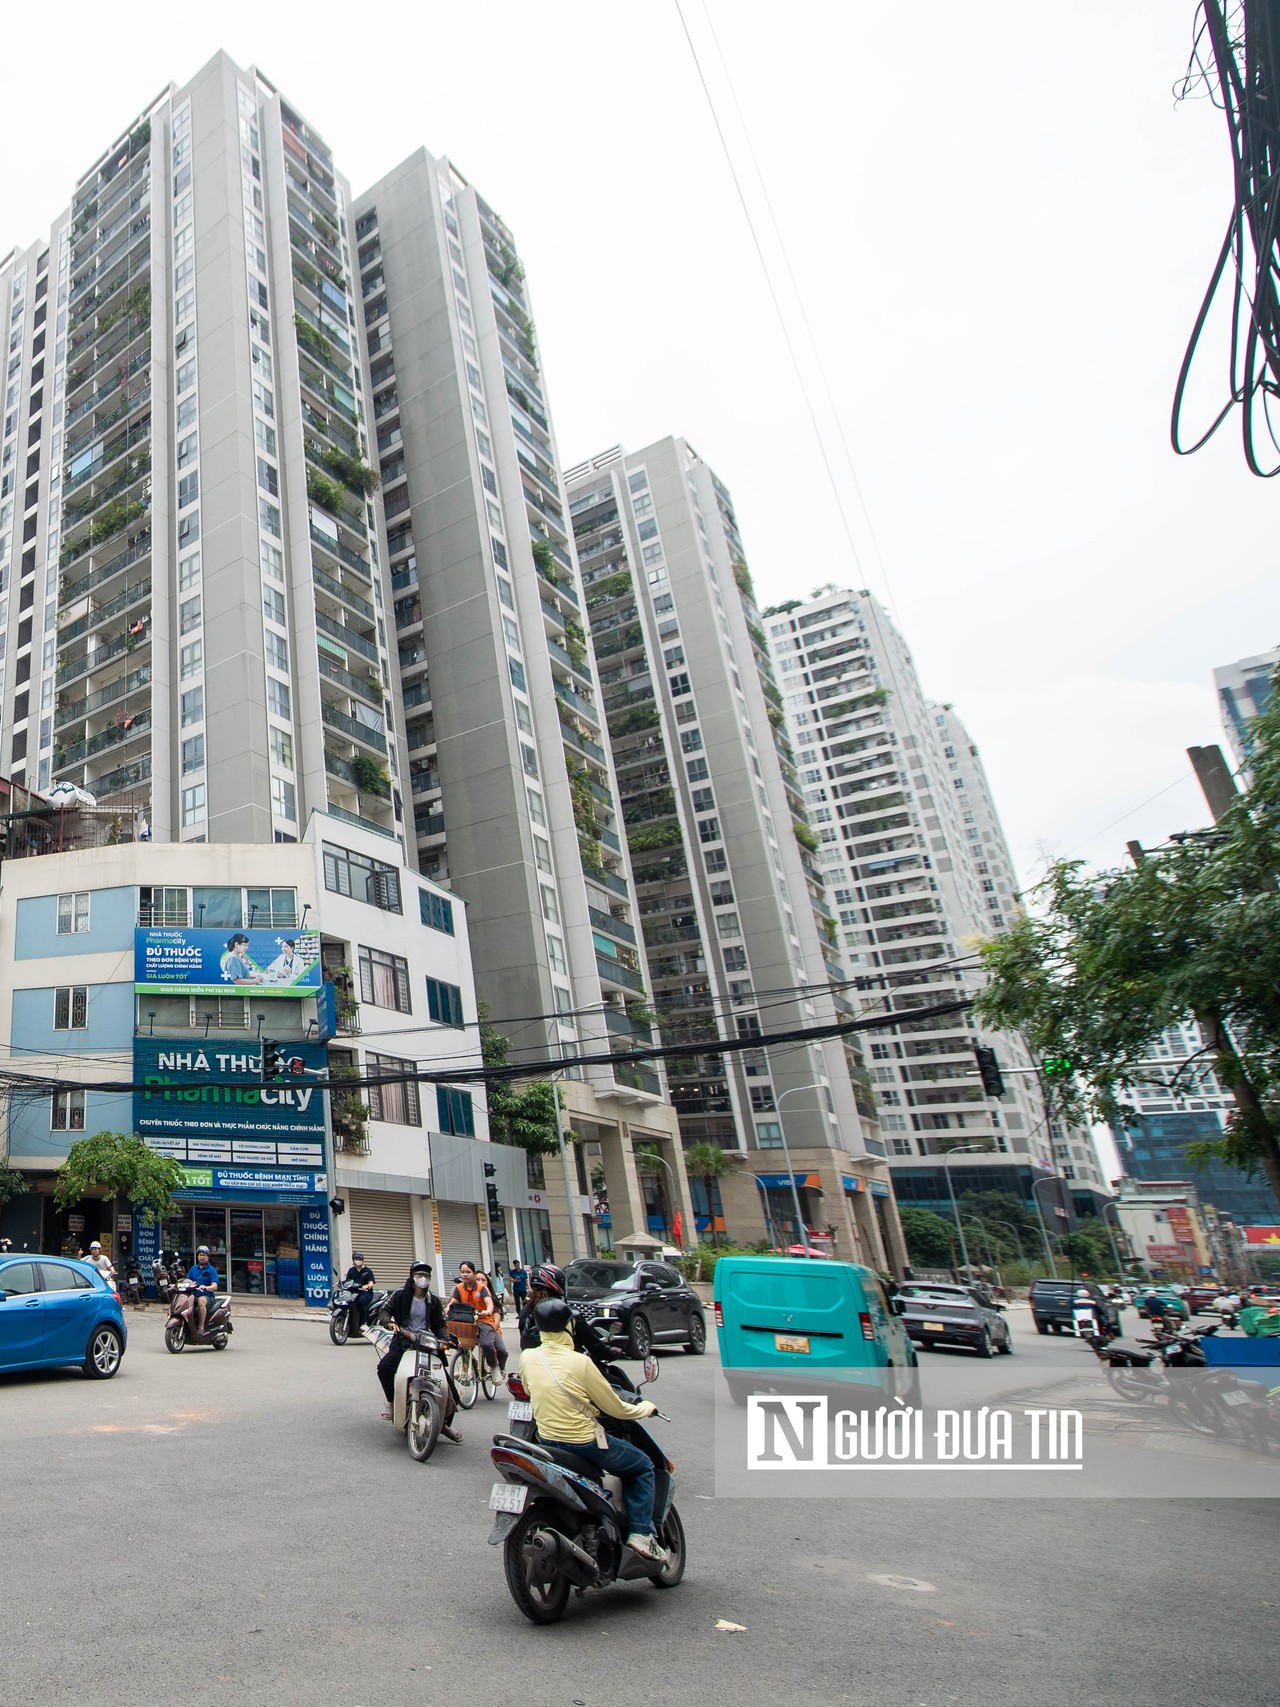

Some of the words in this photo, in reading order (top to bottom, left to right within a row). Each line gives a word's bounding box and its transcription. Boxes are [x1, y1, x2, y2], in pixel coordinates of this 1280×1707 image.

[146, 937, 186, 945] Pharmacity
[146, 945, 162, 956] ĐỦ
[164, 945, 202, 956] THUỐC
[158, 1049, 211, 1071] NHÀ
[163, 1119, 183, 1127] THUỐC
[222, 1122, 237, 1130] THỰC
[238, 1121, 255, 1130] PHẨM
[192, 1174, 211, 1185] TỐT
[218, 1170, 227, 1178] ĐỦ
[229, 1171, 253, 1180] THUỐC
[254, 1172, 273, 1181] BỆNH
[292, 1174, 310, 1182] TÍNH
[309, 1210, 320, 1219] ĐỦ
[303, 1221, 328, 1230] THUỐC
[304, 1232, 328, 1241] CHÍNH
[138, 1237, 155, 1246] BỆNH
[140, 1245, 153, 1254] VIỆN
[311, 1262, 324, 1270] GIÁ
[307, 1274, 328, 1282] LUÔN
[306, 1285, 330, 1299] TỐT
